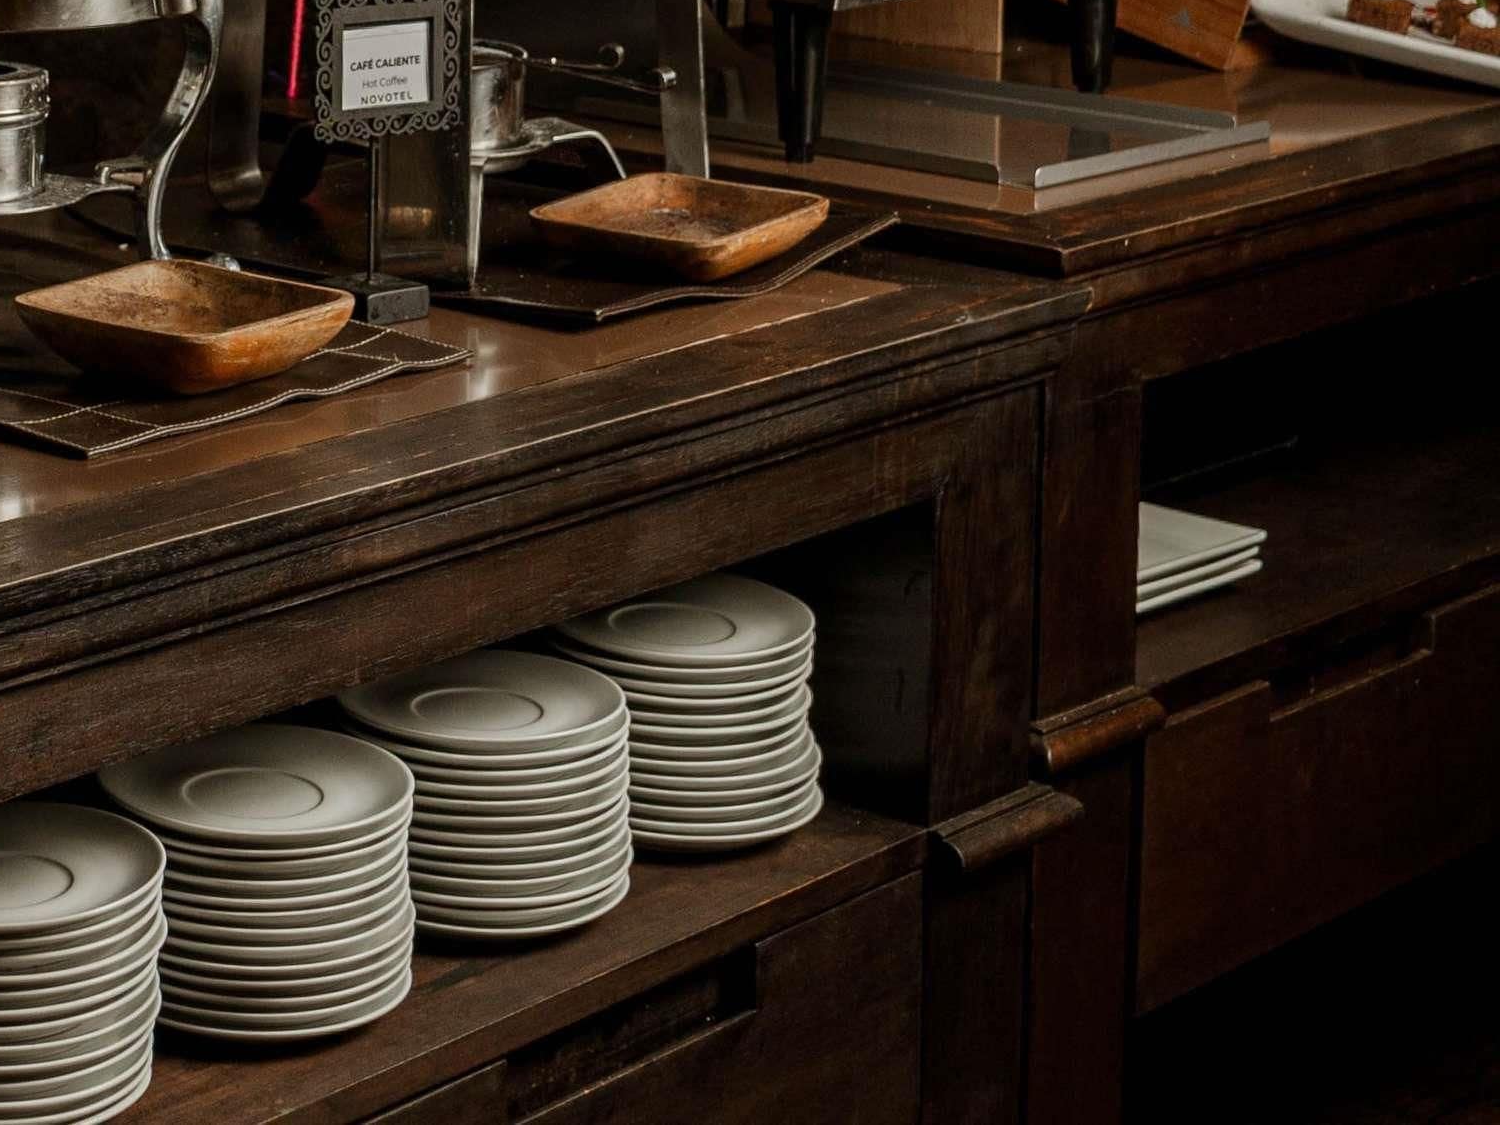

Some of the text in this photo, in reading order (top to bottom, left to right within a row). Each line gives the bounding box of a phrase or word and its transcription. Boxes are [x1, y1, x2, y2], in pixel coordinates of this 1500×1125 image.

[350, 55, 421, 72] CAFÉ CALIENTE
[362, 79, 378, 89] Hot
[360, 91, 413, 106] NOVOTEL
